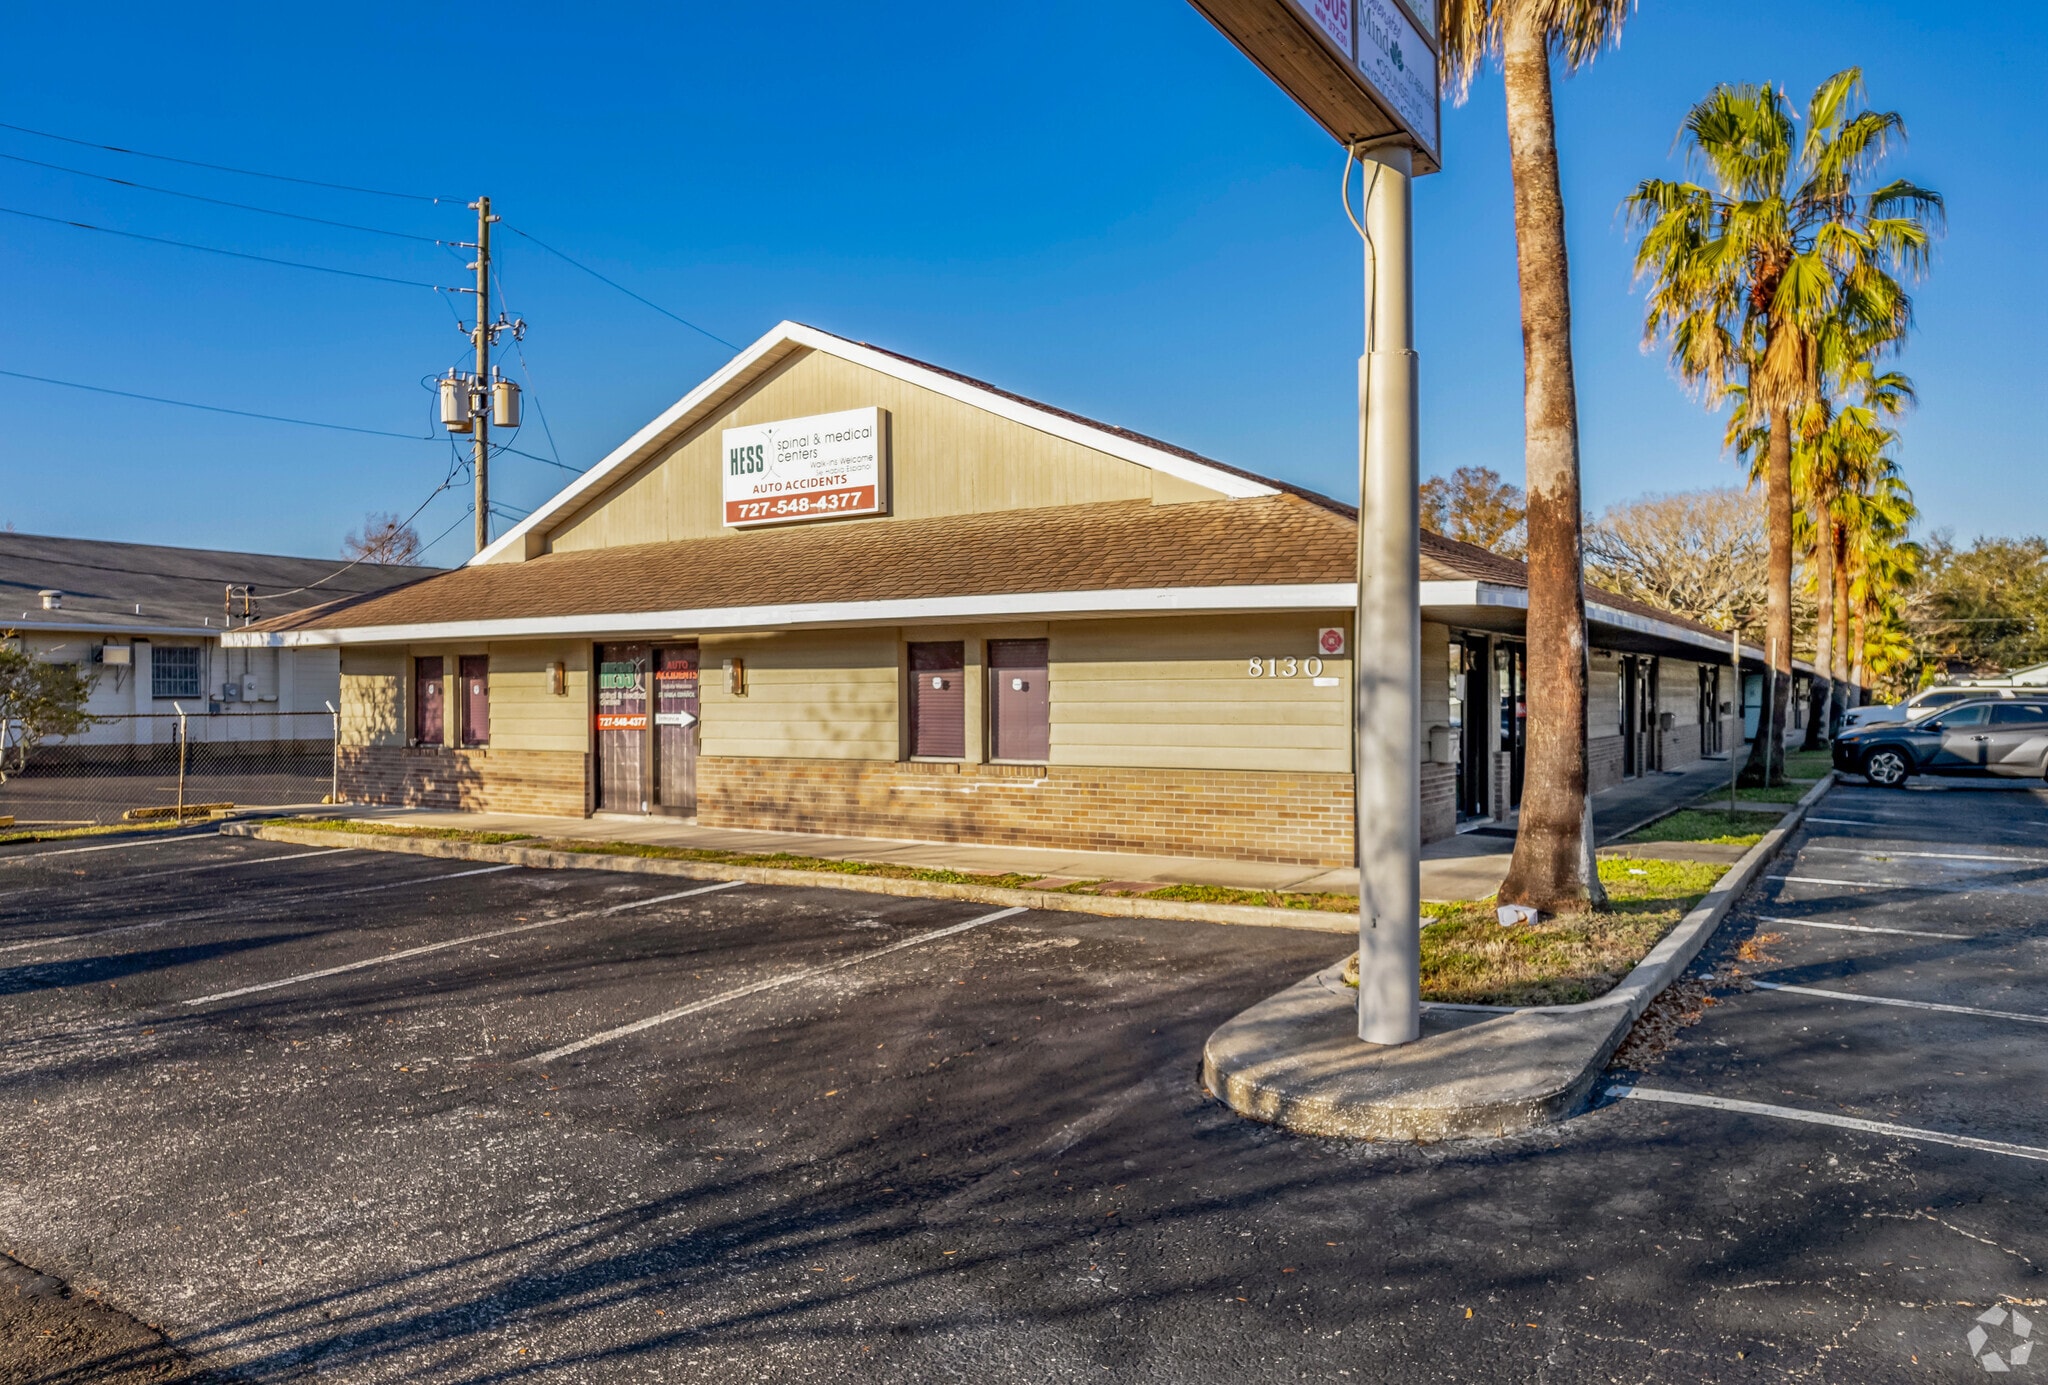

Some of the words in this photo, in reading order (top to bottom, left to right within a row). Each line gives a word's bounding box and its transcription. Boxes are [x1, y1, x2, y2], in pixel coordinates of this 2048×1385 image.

[777, 434, 809, 451] spinal
[813, 433, 821, 446] &
[824, 425, 873, 444] medical
[730, 444, 764, 476] HESS
[777, 447, 818, 463] centers
[840, 454, 873, 465] Welcome
[752, 482, 783, 494] AUTO
[785, 474, 848, 491] ACCIDENTS
[738, 491, 863, 518] 727-548-4377
[666, 660, 689, 670] AUTO
[1248, 656, 1323, 678] 8130
